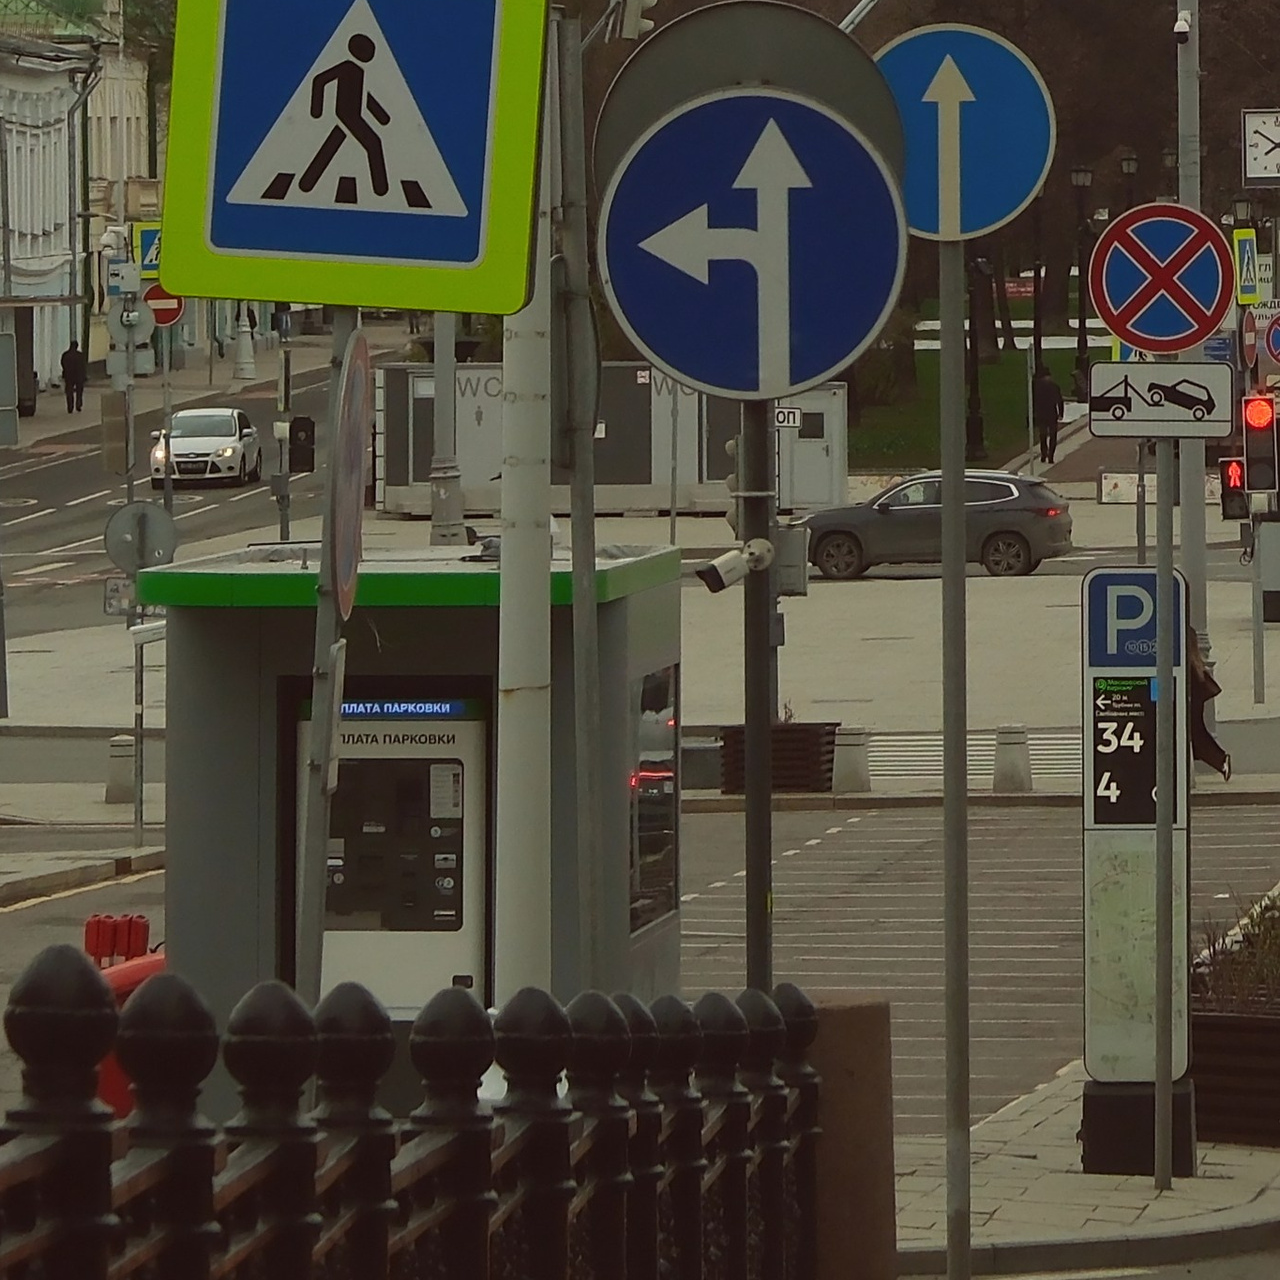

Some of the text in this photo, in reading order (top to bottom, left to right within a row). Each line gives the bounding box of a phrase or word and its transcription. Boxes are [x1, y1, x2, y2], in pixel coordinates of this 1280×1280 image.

[457, 377, 502, 397] WC
[776, 410, 796, 424] ОП
[1107, 585, 1153, 654] P
[340, 703, 450, 714] ПЛАТА ПАРКОВКИ
[340, 734, 456, 745] ЛАТА ПАРКОВКИ
[1097, 722, 1144, 753] 34
[1096, 772, 1120, 803] 4
